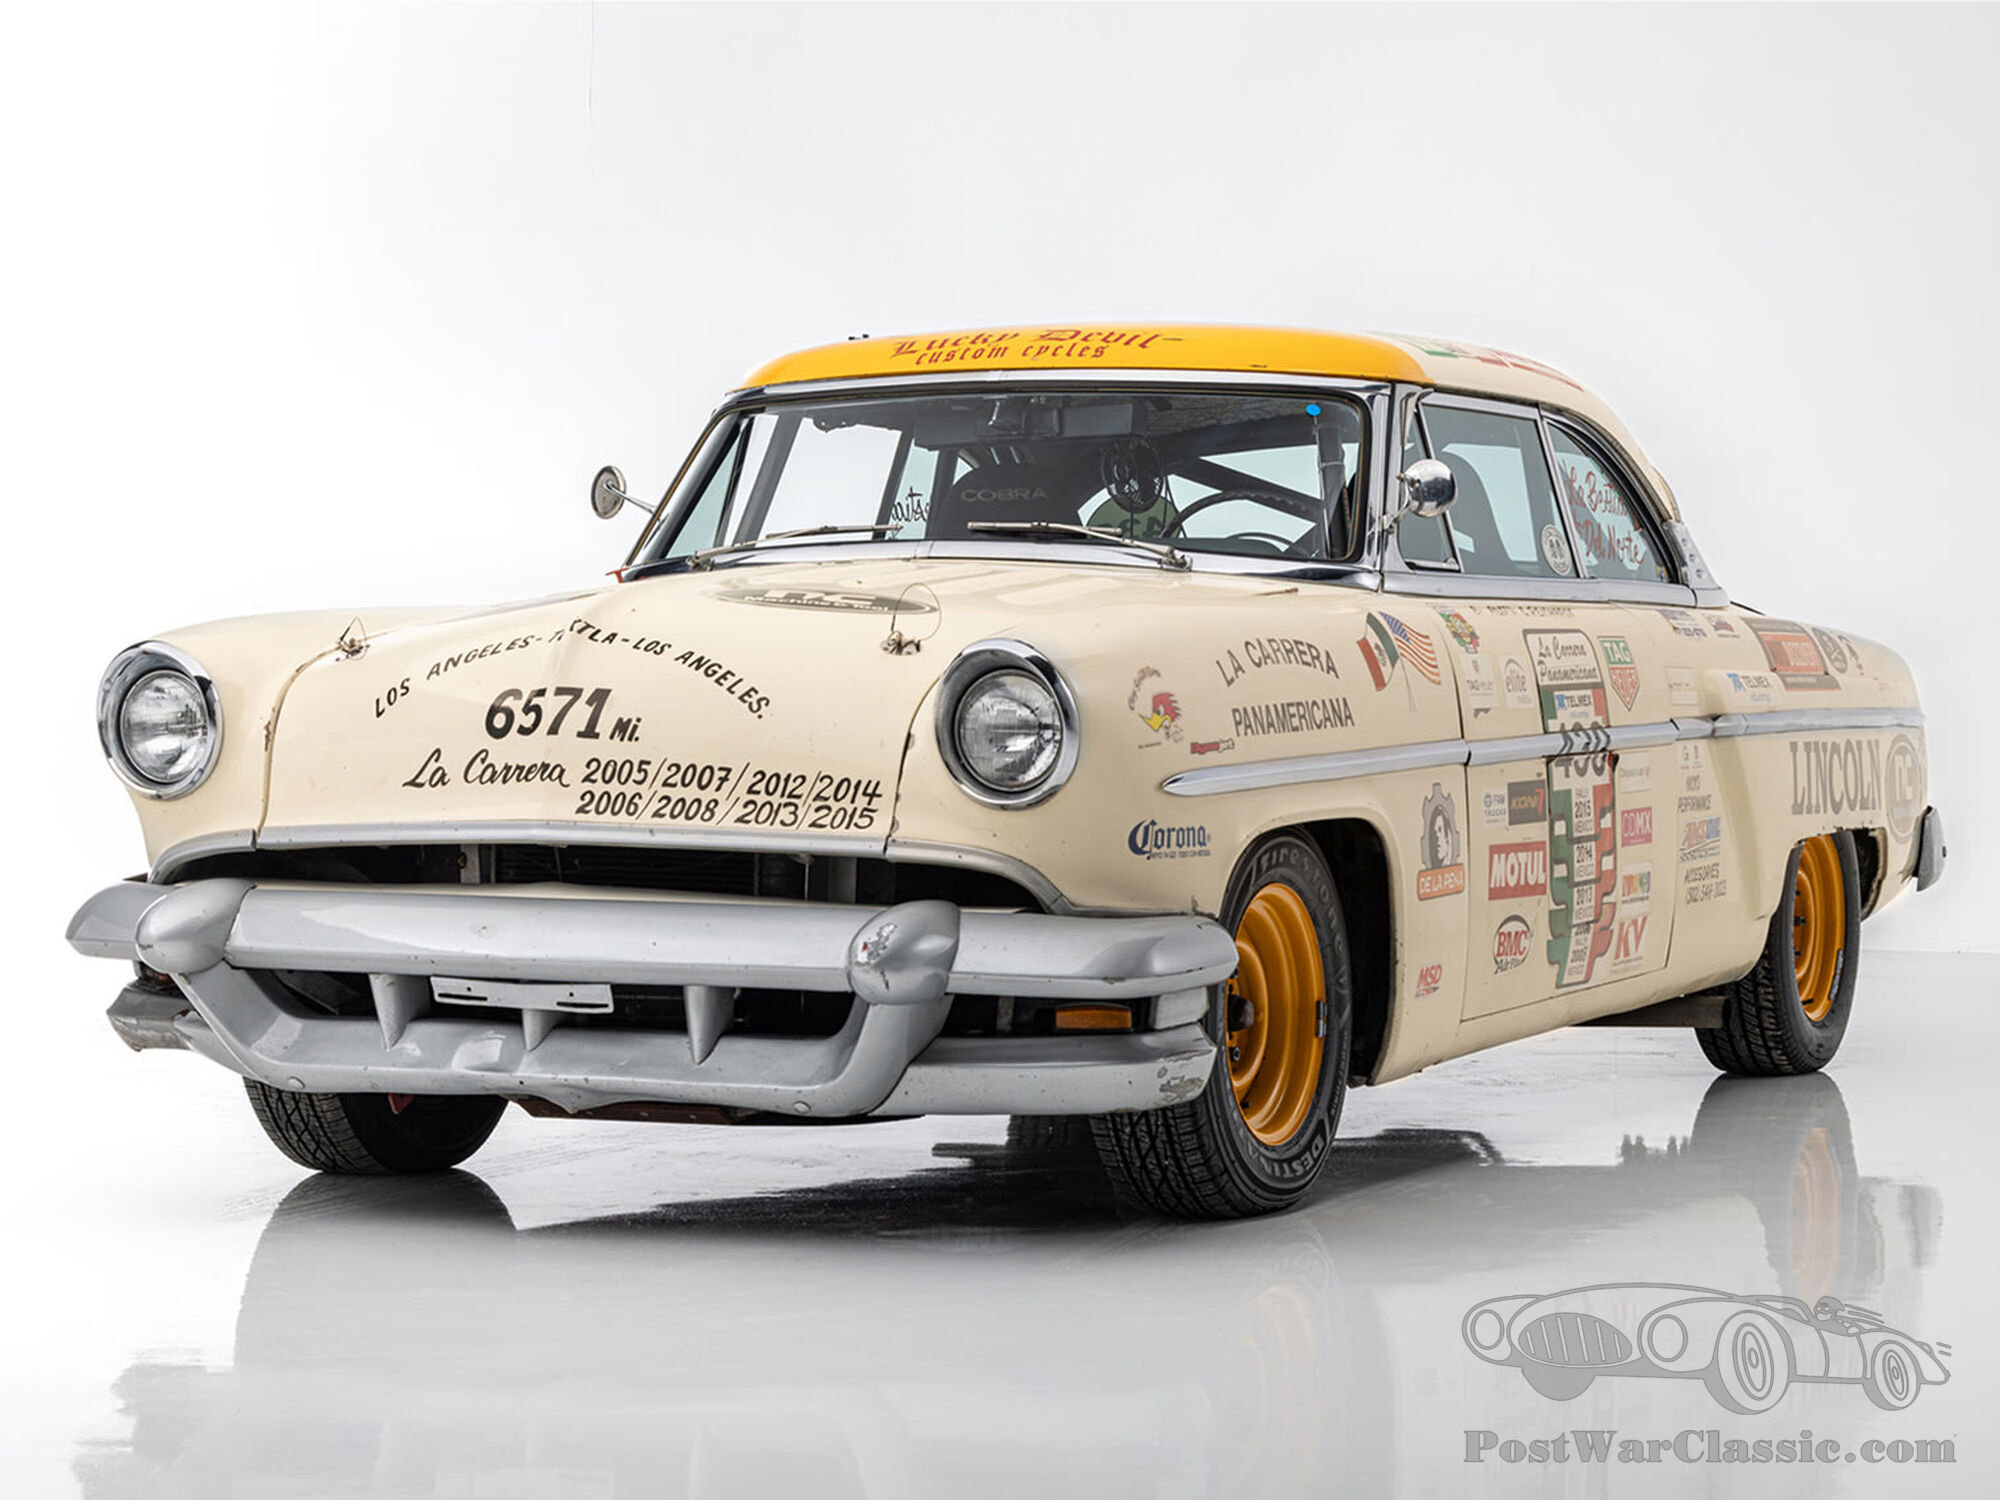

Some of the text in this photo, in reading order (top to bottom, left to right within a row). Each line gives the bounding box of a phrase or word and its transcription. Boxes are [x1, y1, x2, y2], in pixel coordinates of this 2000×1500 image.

[915, 342, 1106, 366] custom cycles
[961, 488, 1047, 502] COBRA
[1215, 638, 1341, 688] LA CARRERA
[1606, 645, 1634, 665] TAG
[374, 677, 411, 719] LOS
[484, 686, 641, 743] 6571 Mi.
[1231, 697, 1356, 738] PANAMERICANA
[402, 748, 452, 789] La
[462, 749, 571, 789] Carrera
[1790, 739, 1882, 816] LINCOLN
[1127, 818, 1207, 860] Corona
[1489, 849, 1546, 889] MOTUL
[1496, 930, 1529, 958] BMC
[1416, 963, 1442, 990] MSD
